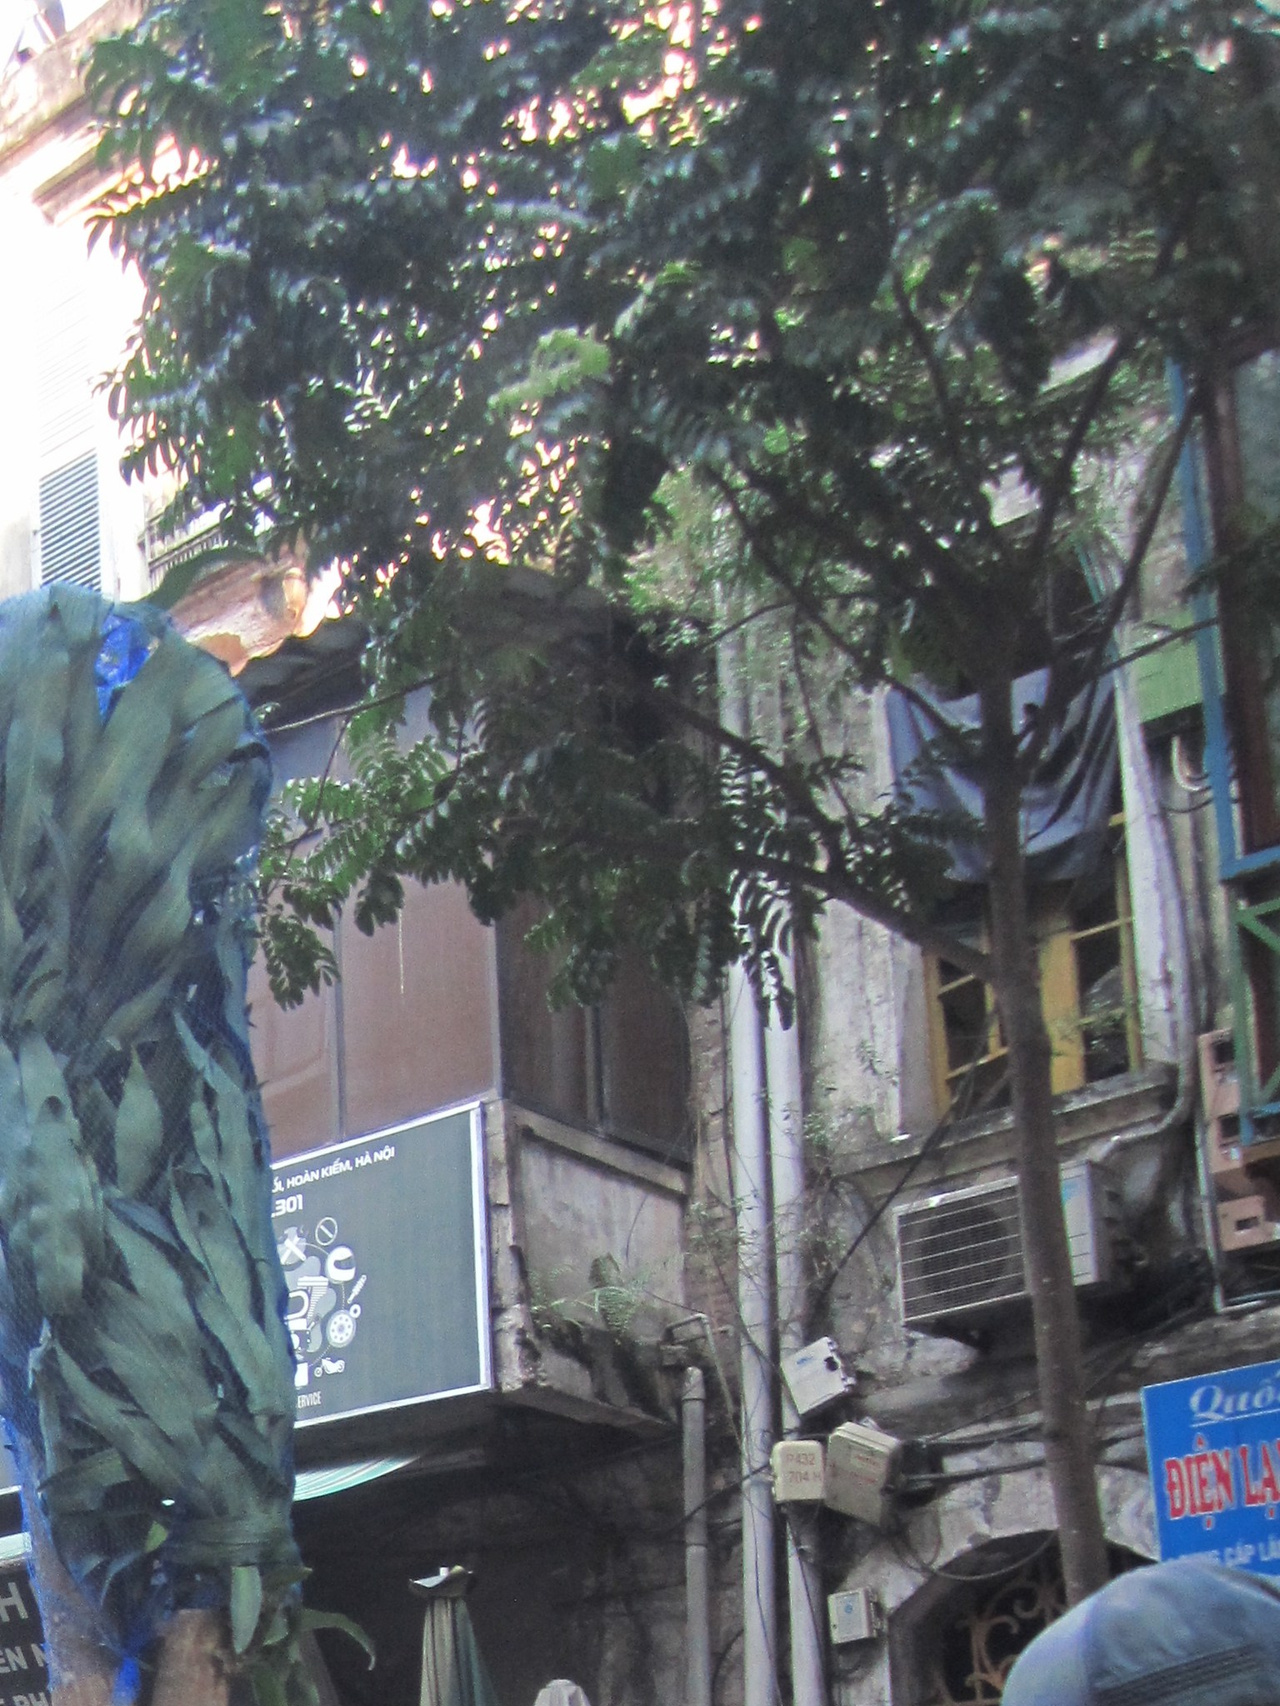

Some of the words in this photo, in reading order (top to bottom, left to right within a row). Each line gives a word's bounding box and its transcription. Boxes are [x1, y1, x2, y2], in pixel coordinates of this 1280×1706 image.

[286, 1170, 320, 1189] HOÀN
[321, 1157, 353, 1179] KIẾM,
[355, 1151, 373, 1168] HÀ
[374, 1145, 396, 1163] NỘI
[1164, 1431, 1237, 1530] ĐIỆN
